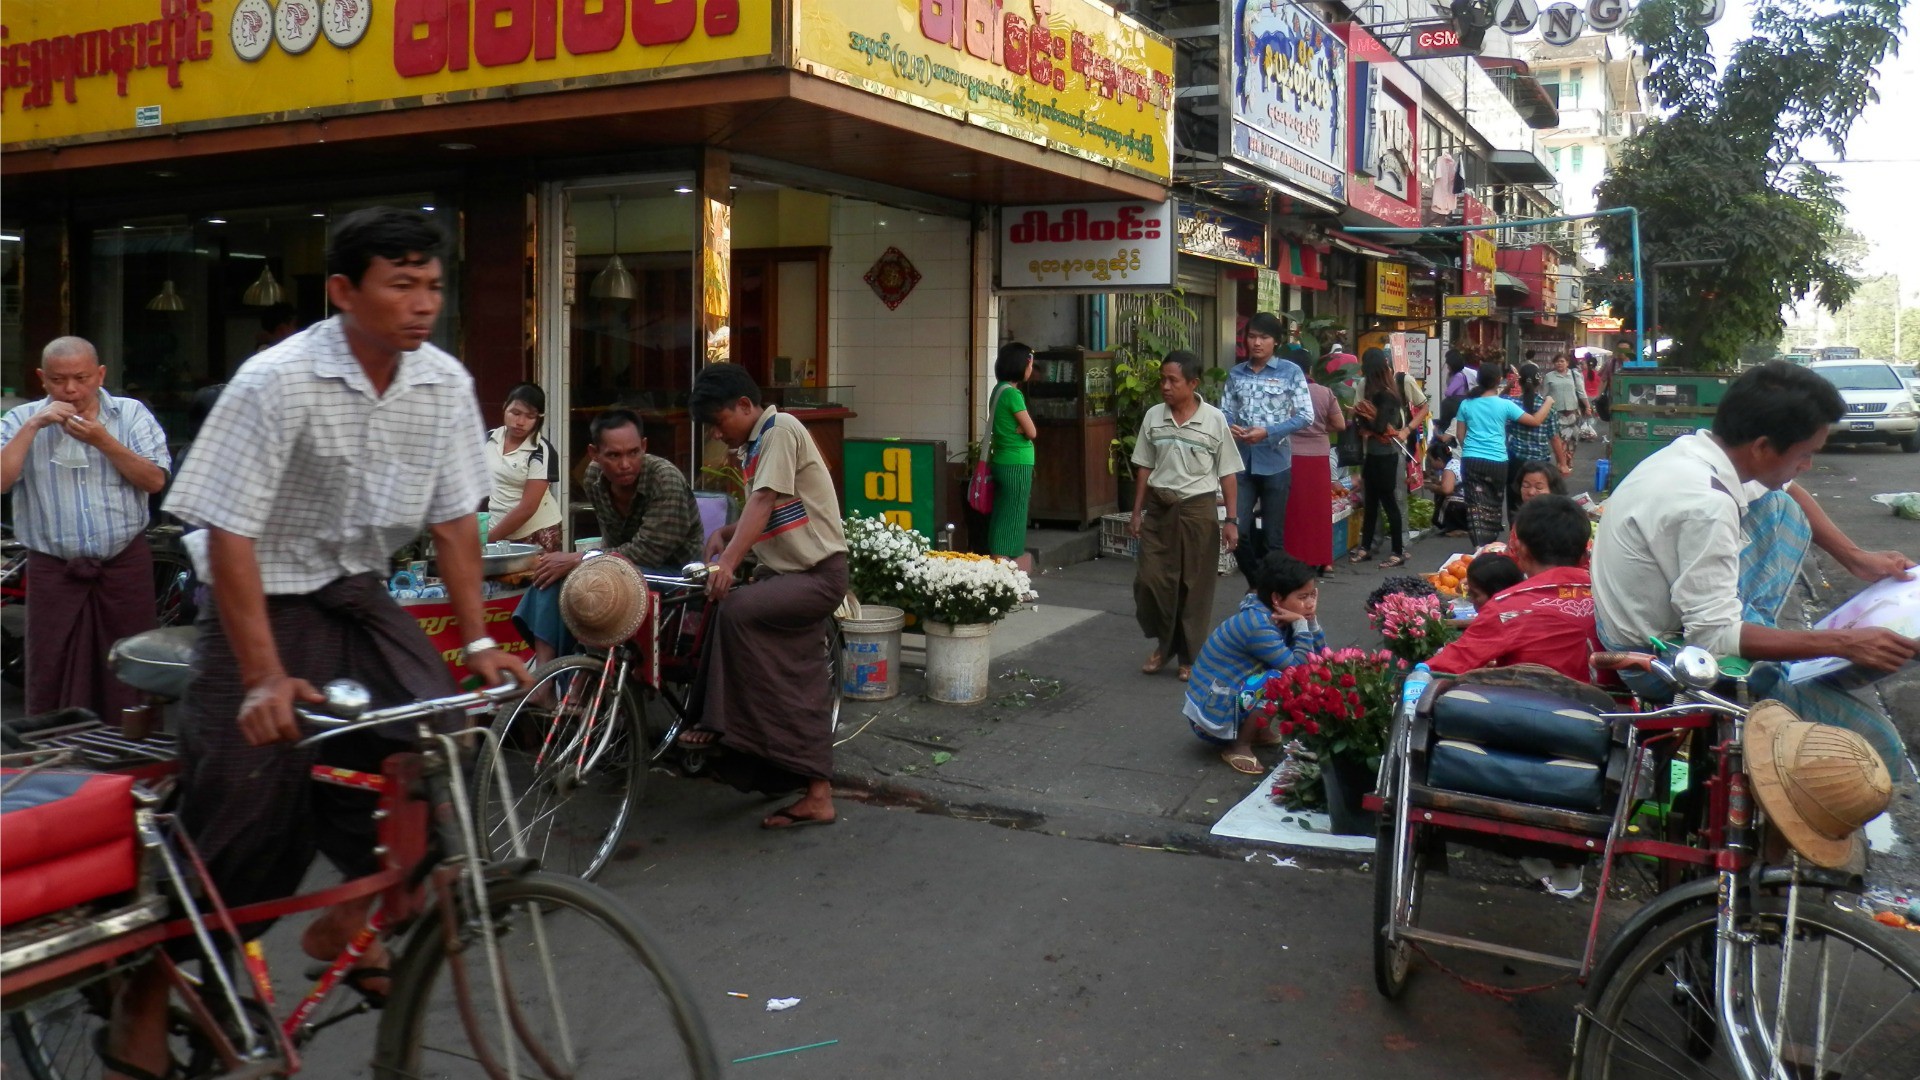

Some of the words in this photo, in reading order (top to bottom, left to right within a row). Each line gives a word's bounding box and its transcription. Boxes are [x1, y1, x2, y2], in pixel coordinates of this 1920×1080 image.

[1418, 30, 1460, 48] GSM
[1010, 206, 1161, 243] ဝါဝါဝင်း
[1028, 248, 1141, 282] ရတနာရွှေဆိုင်
